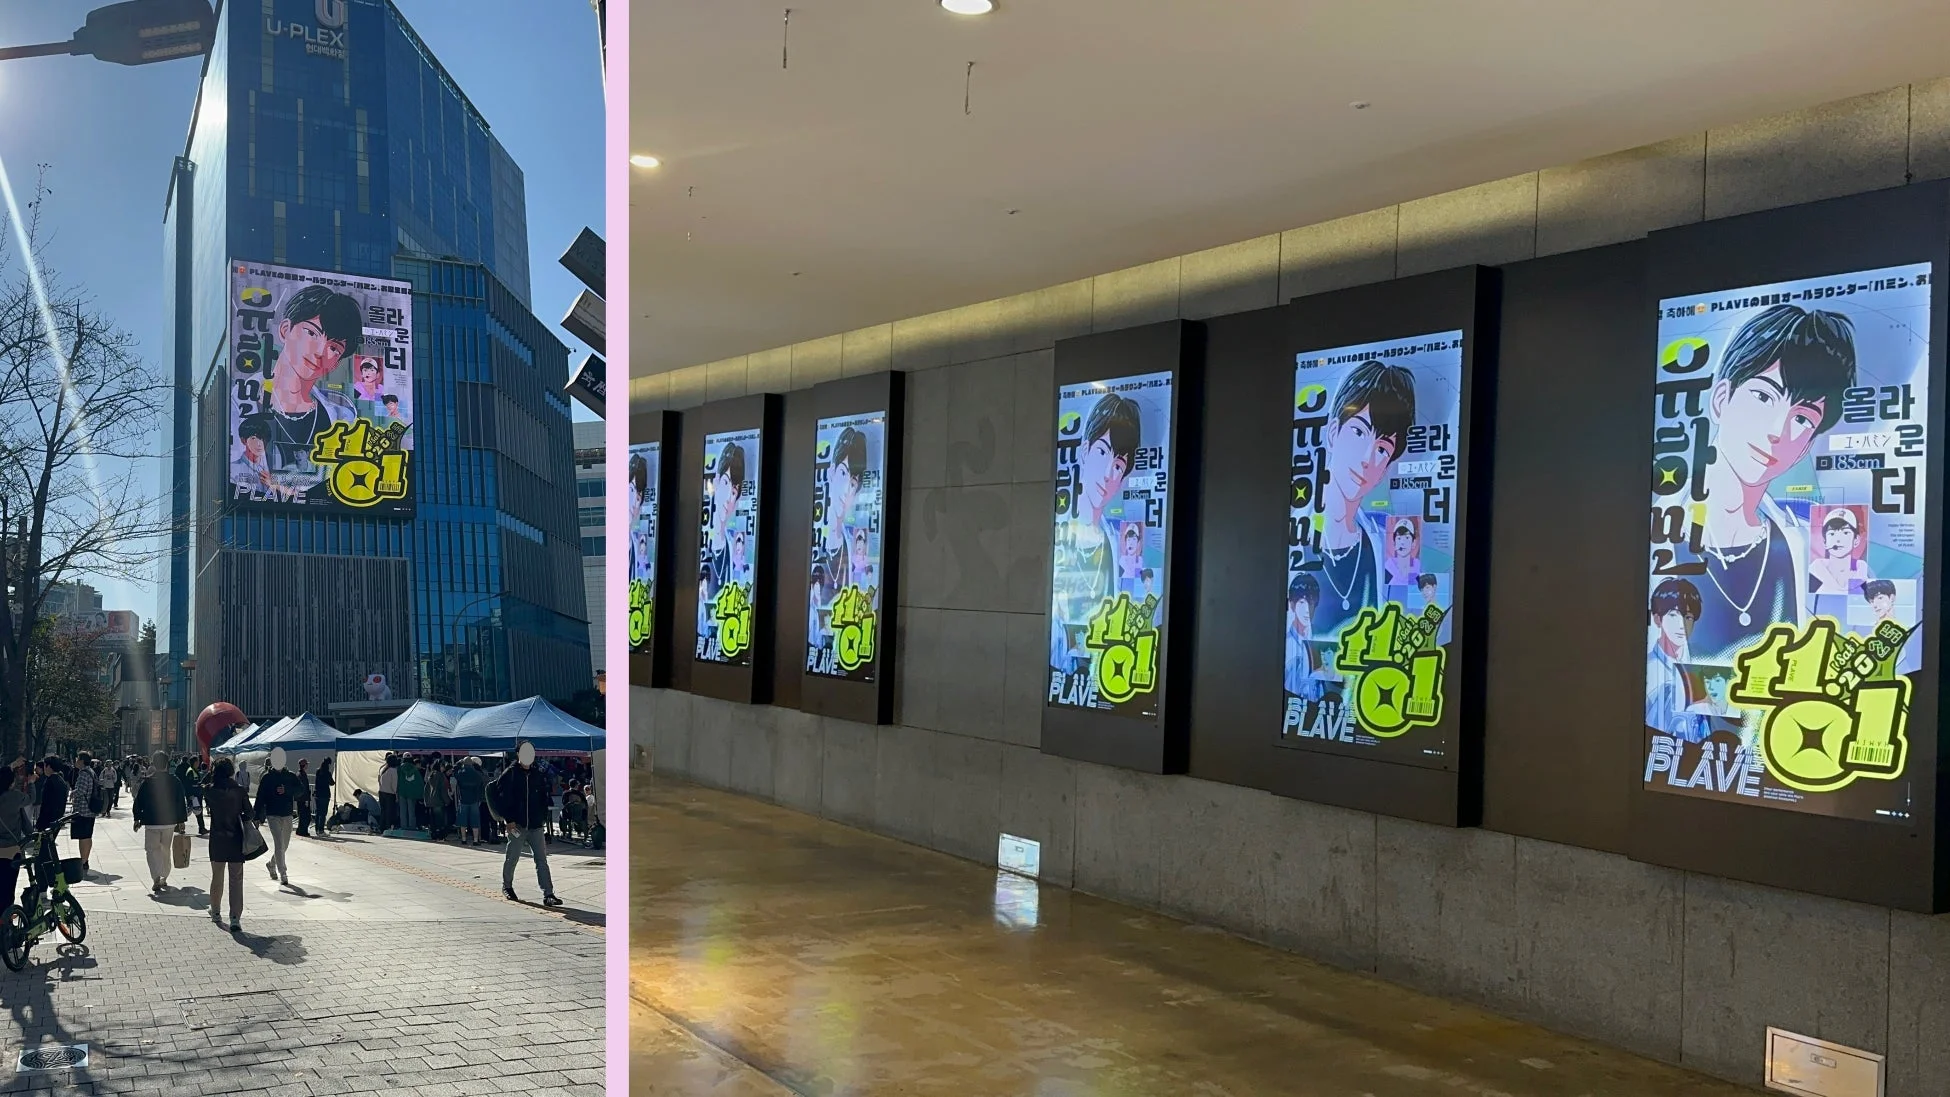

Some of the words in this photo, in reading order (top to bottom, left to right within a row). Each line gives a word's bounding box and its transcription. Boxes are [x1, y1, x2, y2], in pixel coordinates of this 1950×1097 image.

[266, 17, 345, 48] U-PLEX
[1842, 383, 1916, 424] 올라
[1407, 423, 1451, 454] 올라
[1830, 453, 1881, 470] 185cm
[233, 480, 307, 505] PLAVE
[1399, 477, 1429, 489] 185cm
[806, 651, 839, 676] PLAVE
[1838, 622, 1903, 691] 2025
[1049, 677, 1098, 708] PLAVE
[1283, 704, 1356, 743] PLAVE
[1644, 744, 1763, 798] PLAVE
